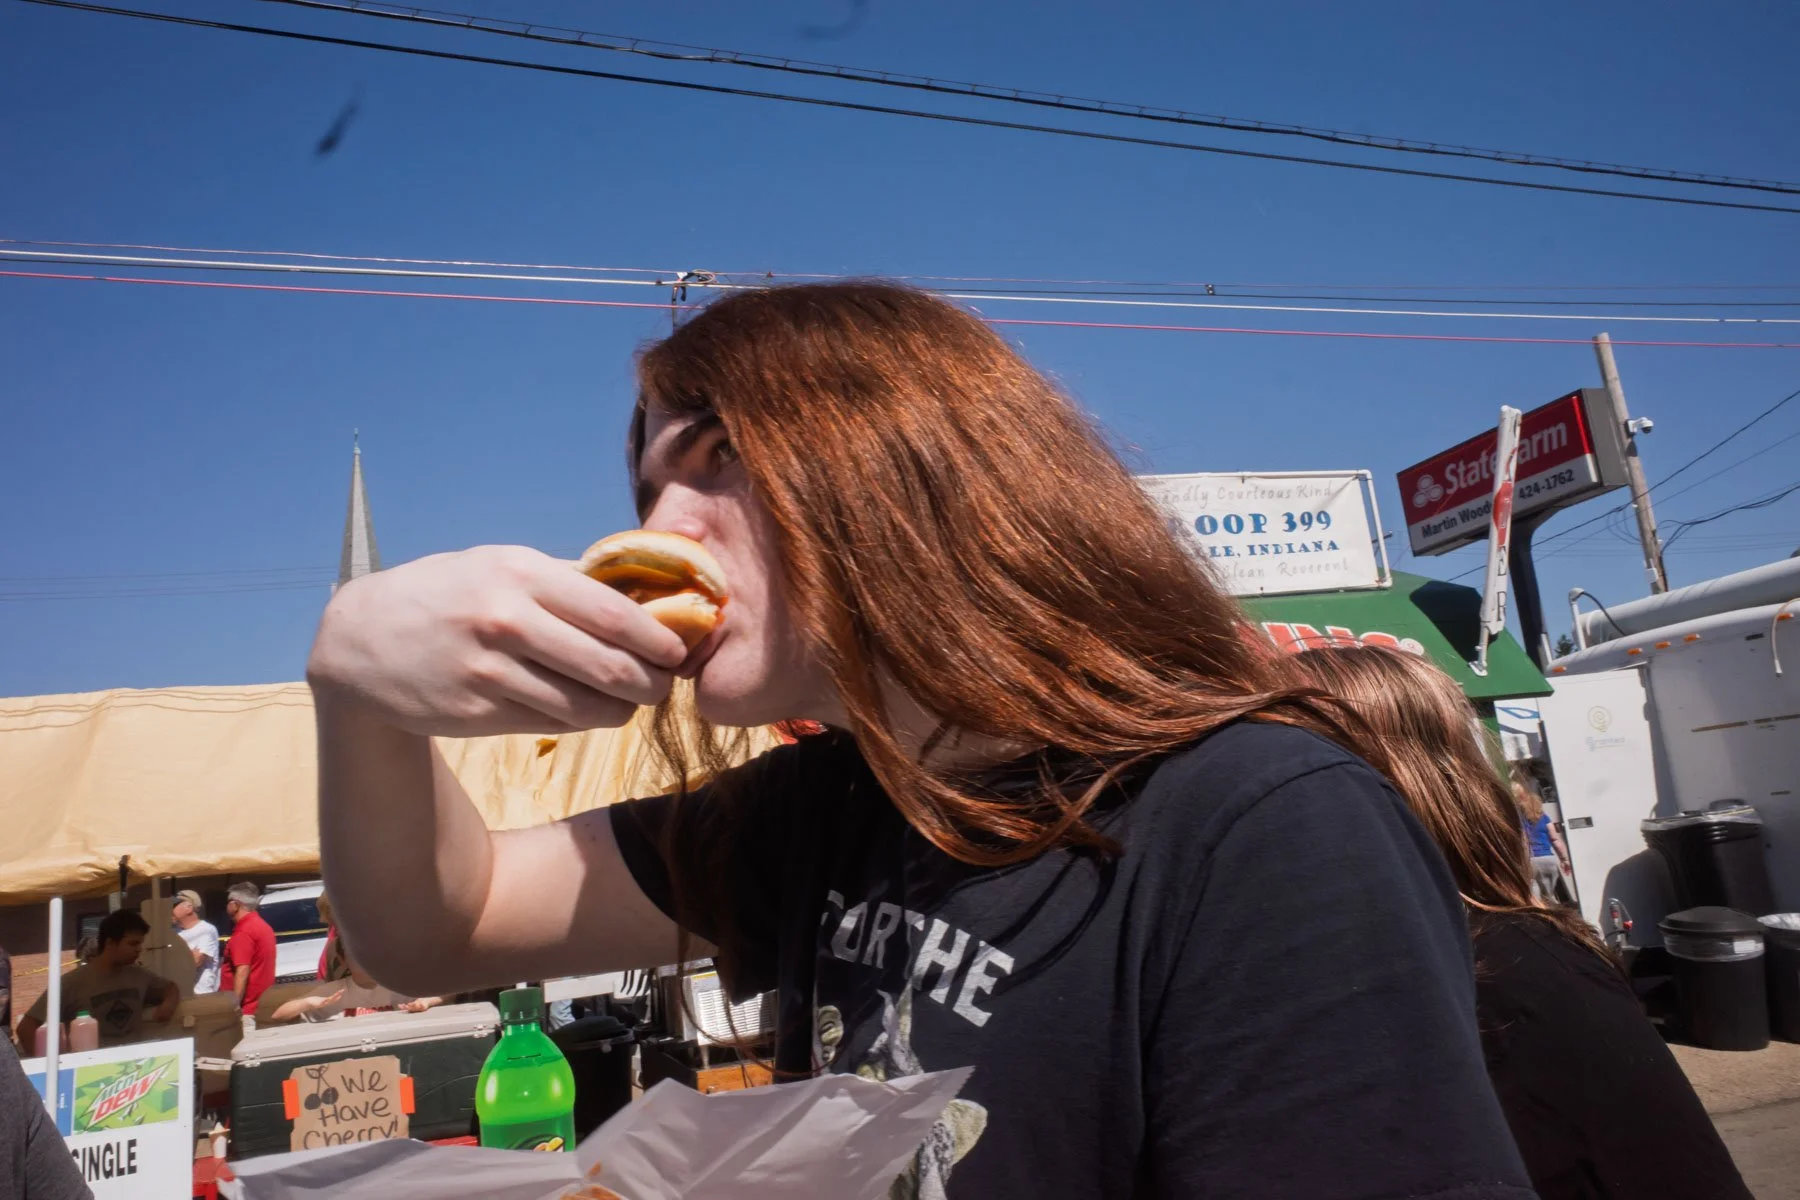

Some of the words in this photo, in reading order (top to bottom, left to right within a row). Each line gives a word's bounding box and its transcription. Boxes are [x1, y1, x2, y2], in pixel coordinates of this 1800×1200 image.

[1517, 421, 1568, 465] arm
[1159, 485, 1209, 510] endly
[1217, 485, 1291, 501] Courteous
[1421, 516, 1458, 539] Martin
[1458, 500, 1493, 525] Wood
[1519, 468, 1575, 500] 424-1762
[1194, 513, 1268, 536] OOP
[1281, 510, 1332, 533] 399
[1208, 545, 1241, 558] LE,
[1247, 540, 1340, 556] INDIANA
[1280, 557, 1349, 577] Reverent
[341, 1068, 388, 1094] We
[317, 1096, 393, 1127] Have
[73, 1138, 138, 1183] INGLE
